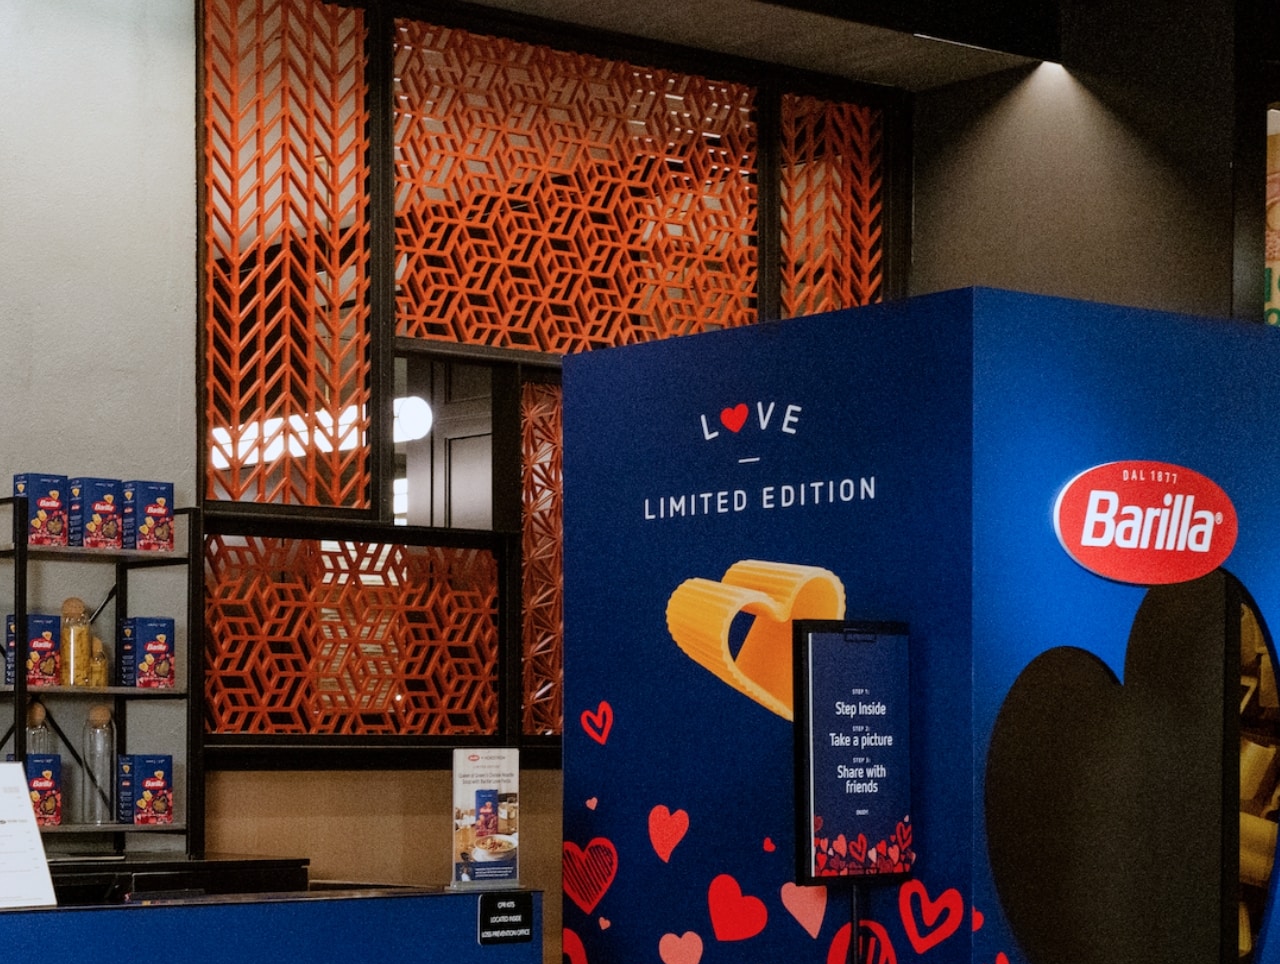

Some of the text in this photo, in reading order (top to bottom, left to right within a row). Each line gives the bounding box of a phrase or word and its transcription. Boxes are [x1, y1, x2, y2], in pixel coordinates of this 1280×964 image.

[1122, 469, 1177, 484] DAL 1877
[644, 476, 875, 520] LIMITED EDITION
[1080, 489, 1216, 553] Barilla
[835, 701, 886, 718] Step Inside
[829, 732, 893, 749] Take a picture
[837, 764, 886, 778] Share with
[846, 780, 878, 793] friends
